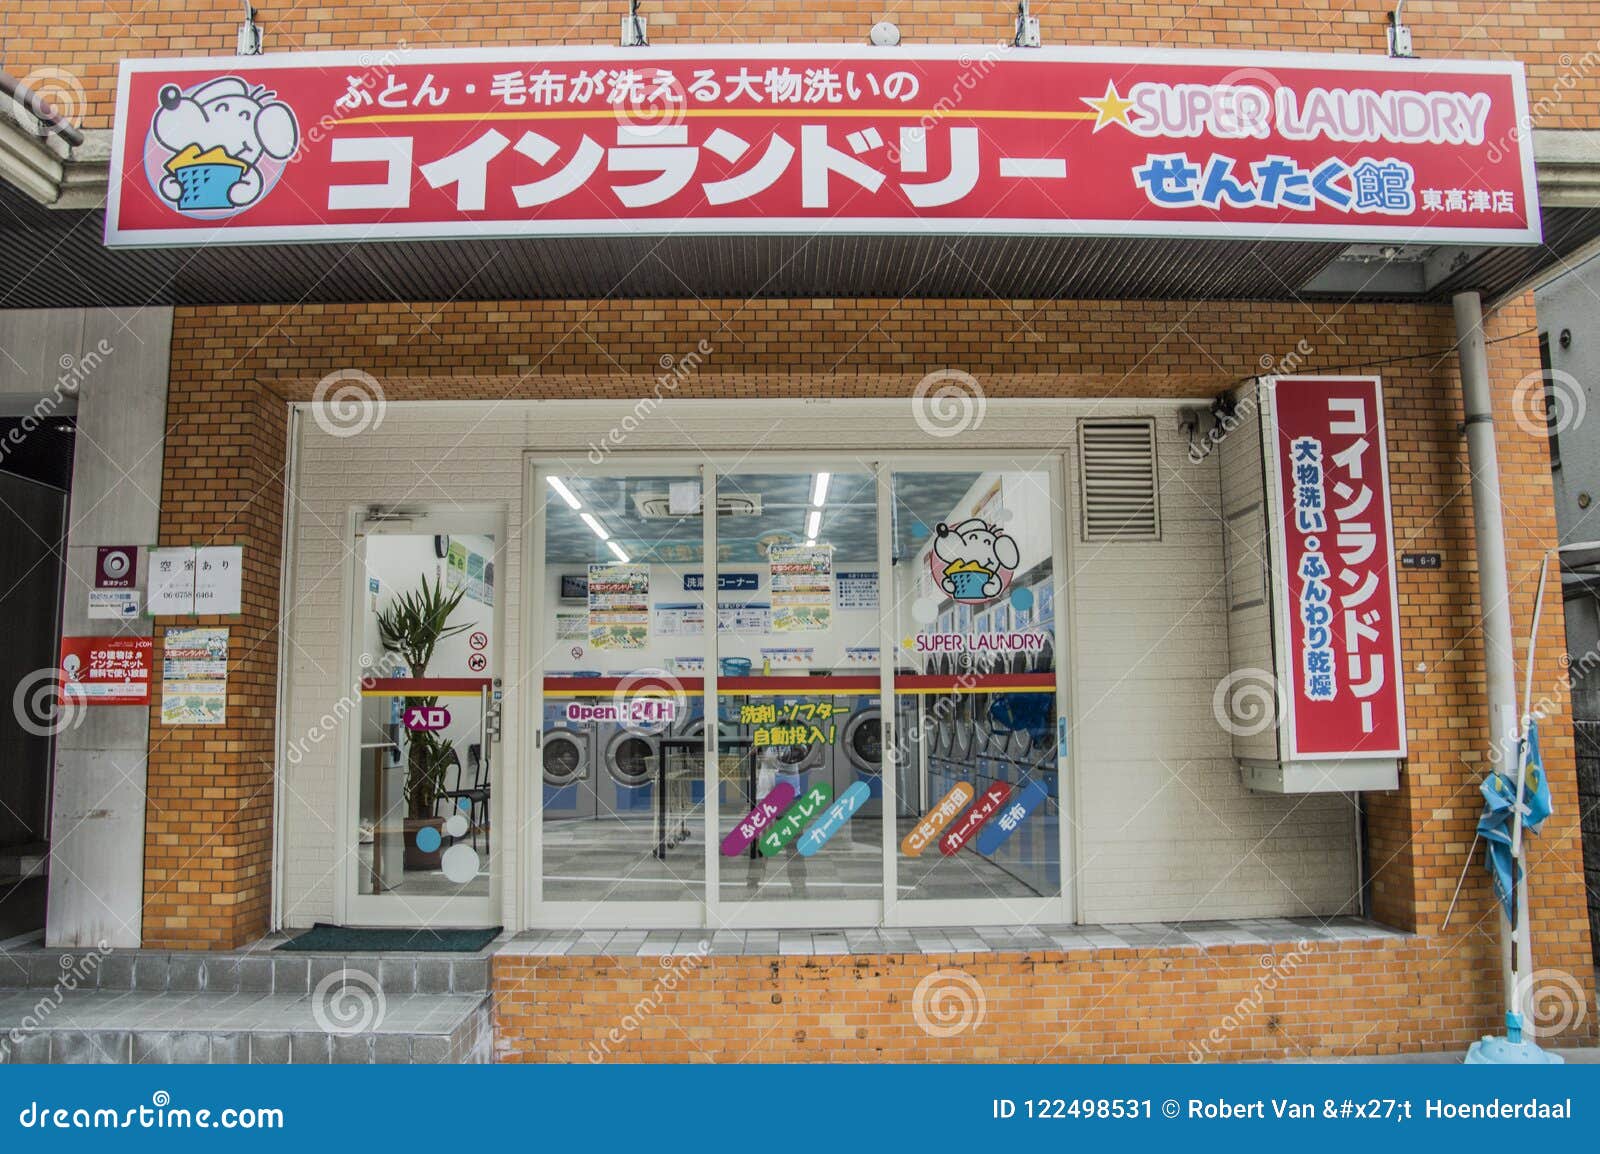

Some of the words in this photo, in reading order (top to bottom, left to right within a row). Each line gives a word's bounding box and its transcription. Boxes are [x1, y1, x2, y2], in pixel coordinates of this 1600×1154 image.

[336, 67, 919, 108] ふとん・毛布が洗える大物洗いの
[1134, 86, 1272, 137] SUPER
[1284, 86, 1489, 143] LAUNDRY
[327, 125, 1066, 211] コインランドリー
[1136, 155, 1413, 214] せんたく館
[1421, 189, 1514, 214] 東高津店
[1294, 438, 1333, 698] 大物洗い・ふんわり乾燥
[1327, 397, 1385, 734] コインランドリー
[916, 634, 962, 651] SUPER
[969, 633, 1044, 650] LAUNDRY
[410, 710, 445, 727] 入口
[740, 803, 778, 839] ふとん
[766, 788, 827, 848] マットレス
[810, 795, 857, 844] カーテン
[908, 789, 969, 851] こたつ布団
[946, 790, 1003, 849] カーペット
[998, 803, 1027, 833] 毛布
